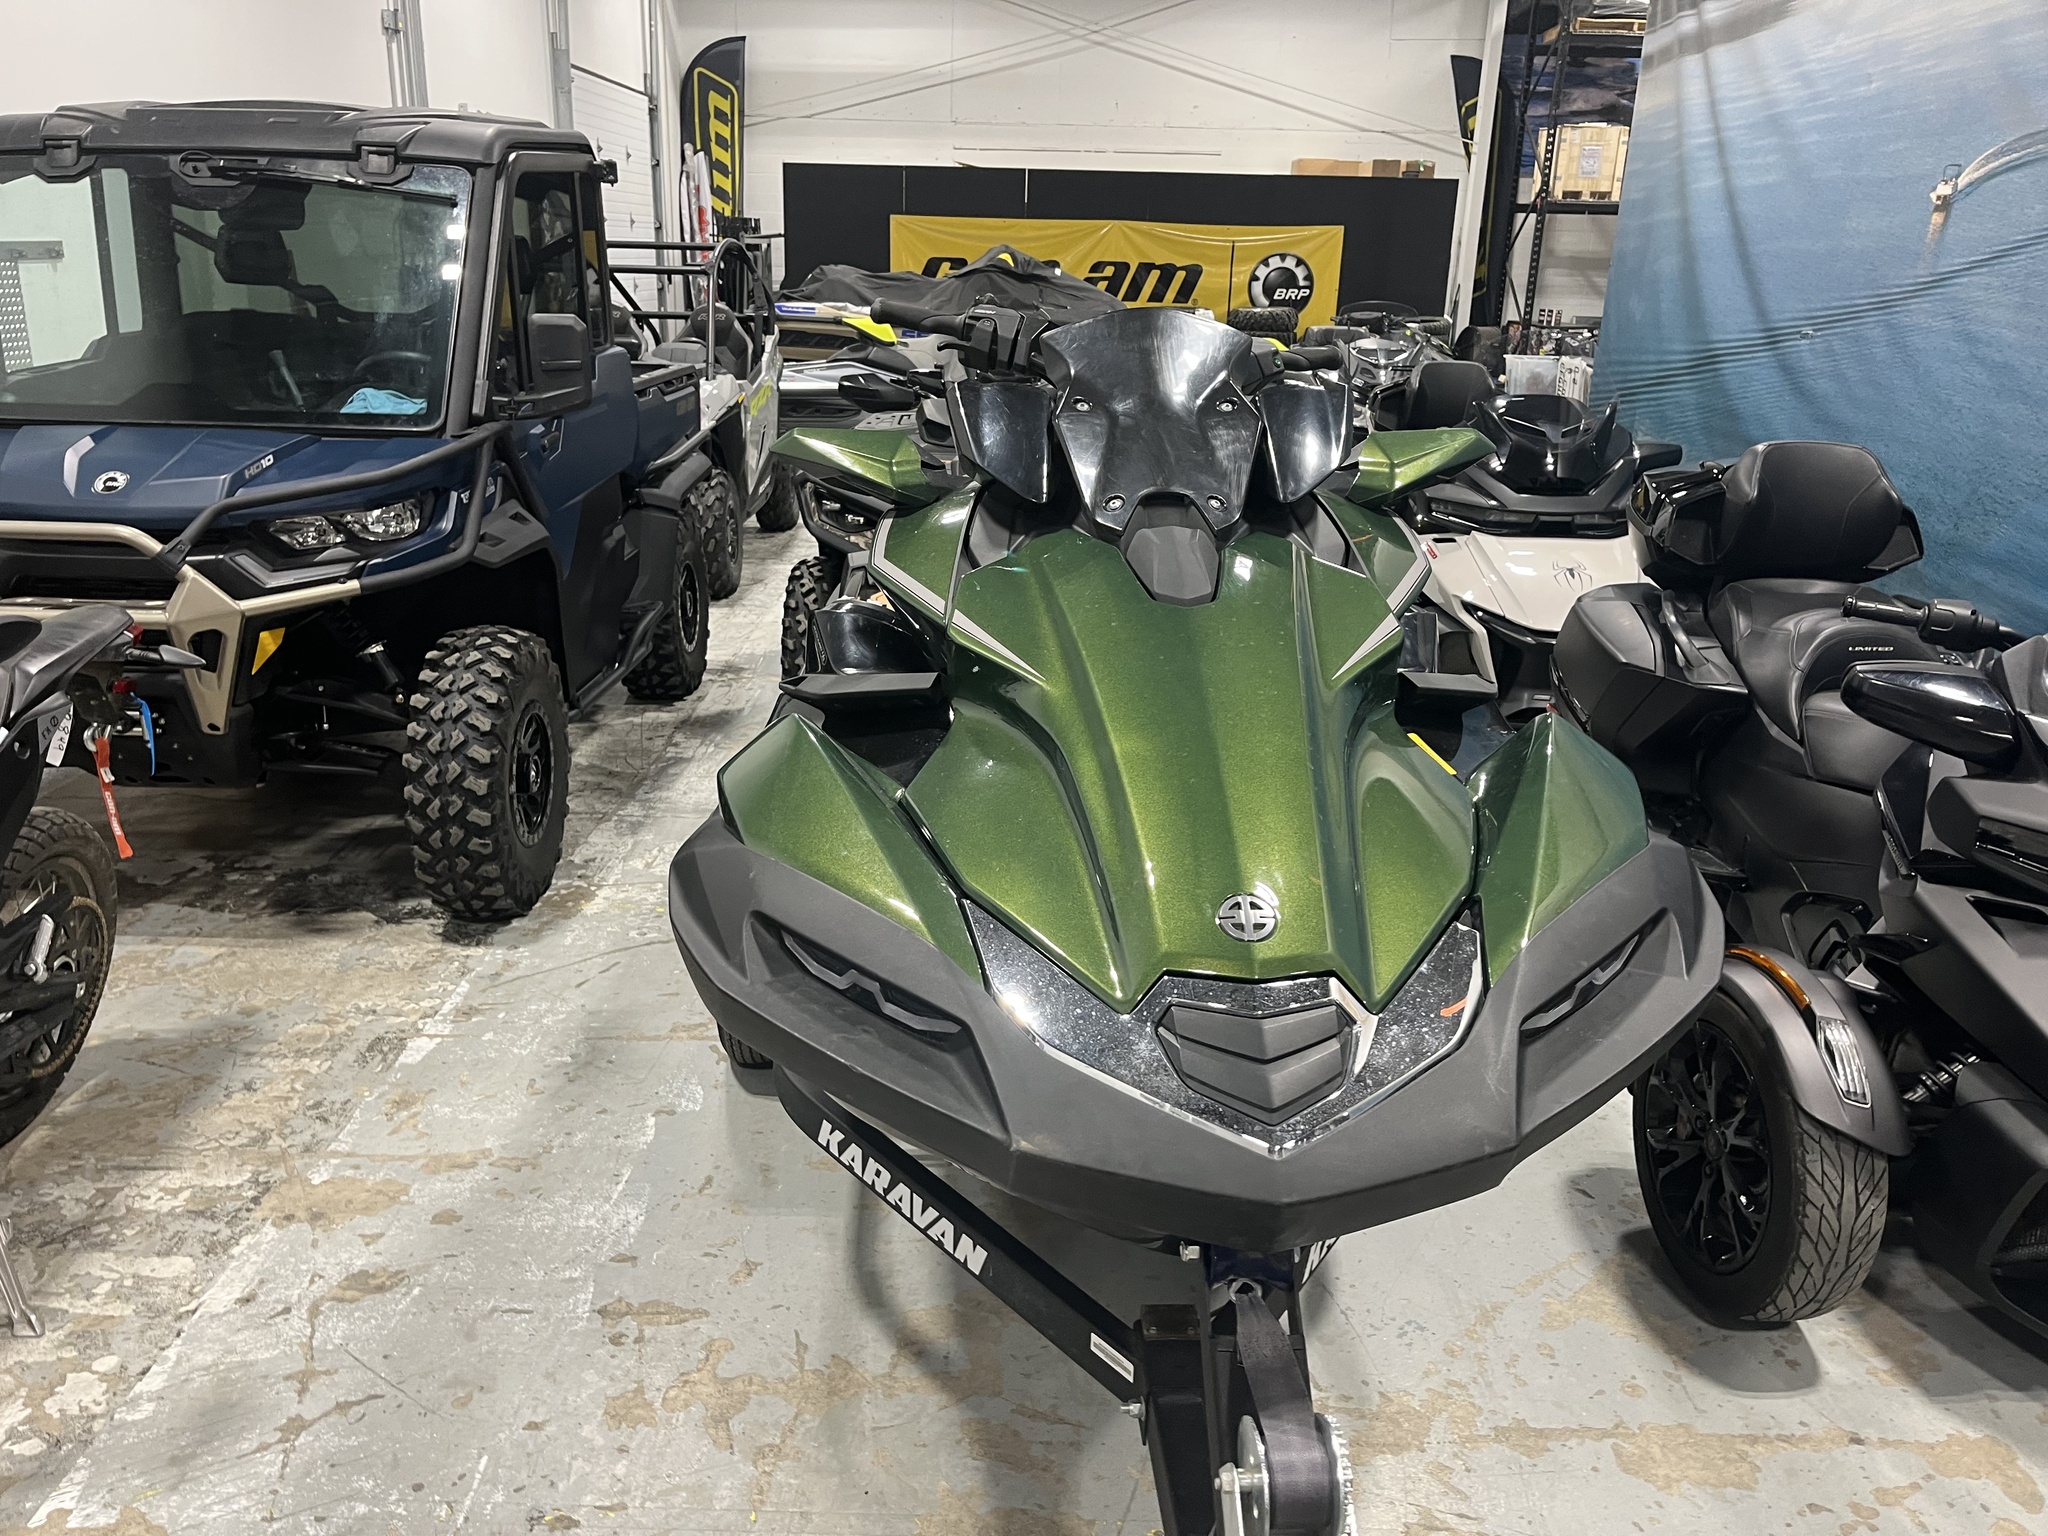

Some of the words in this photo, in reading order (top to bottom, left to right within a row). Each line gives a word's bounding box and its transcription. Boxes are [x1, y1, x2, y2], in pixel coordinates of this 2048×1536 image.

[1273, 287, 1311, 301] BRP
[244, 454, 274, 479] HD10
[817, 1118, 989, 1276] KARAVAN
